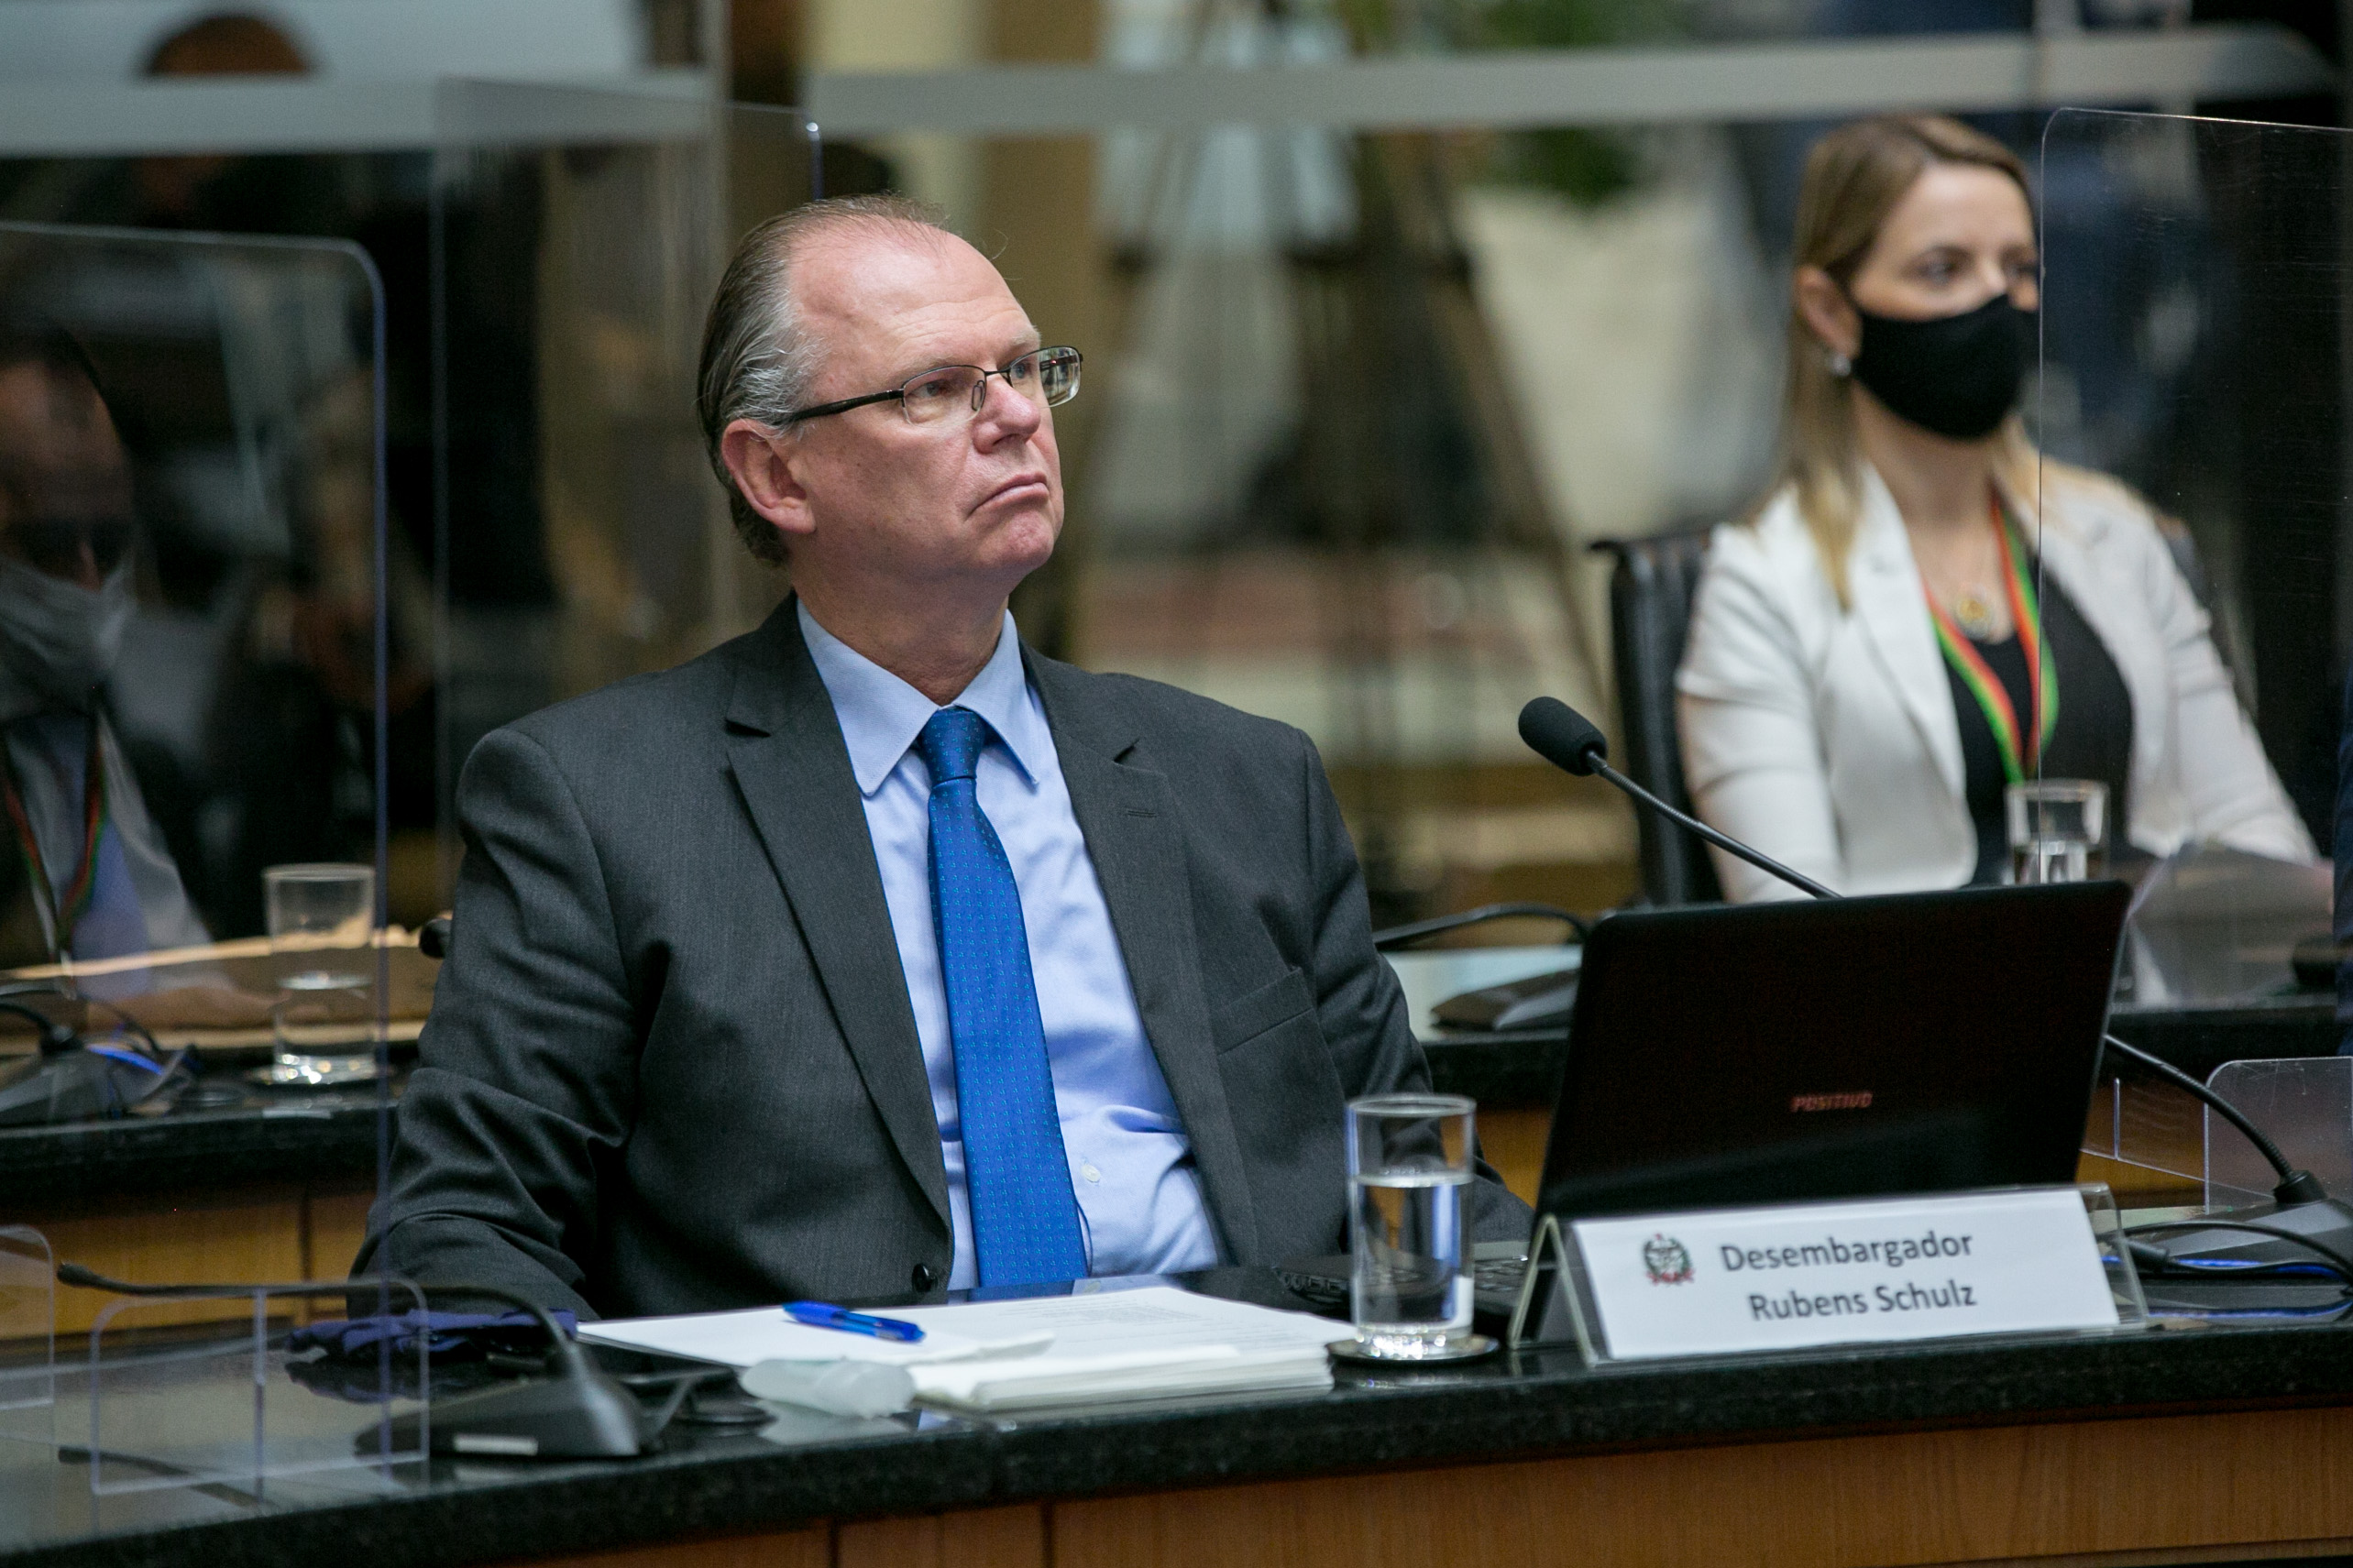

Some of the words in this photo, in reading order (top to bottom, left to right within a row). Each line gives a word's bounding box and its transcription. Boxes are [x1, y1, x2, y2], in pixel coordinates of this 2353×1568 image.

[1720, 1230, 1974, 1272] Desembargador
[1748, 1290, 1869, 1321] Rubens
[1875, 1279, 1977, 1313] Schulz
